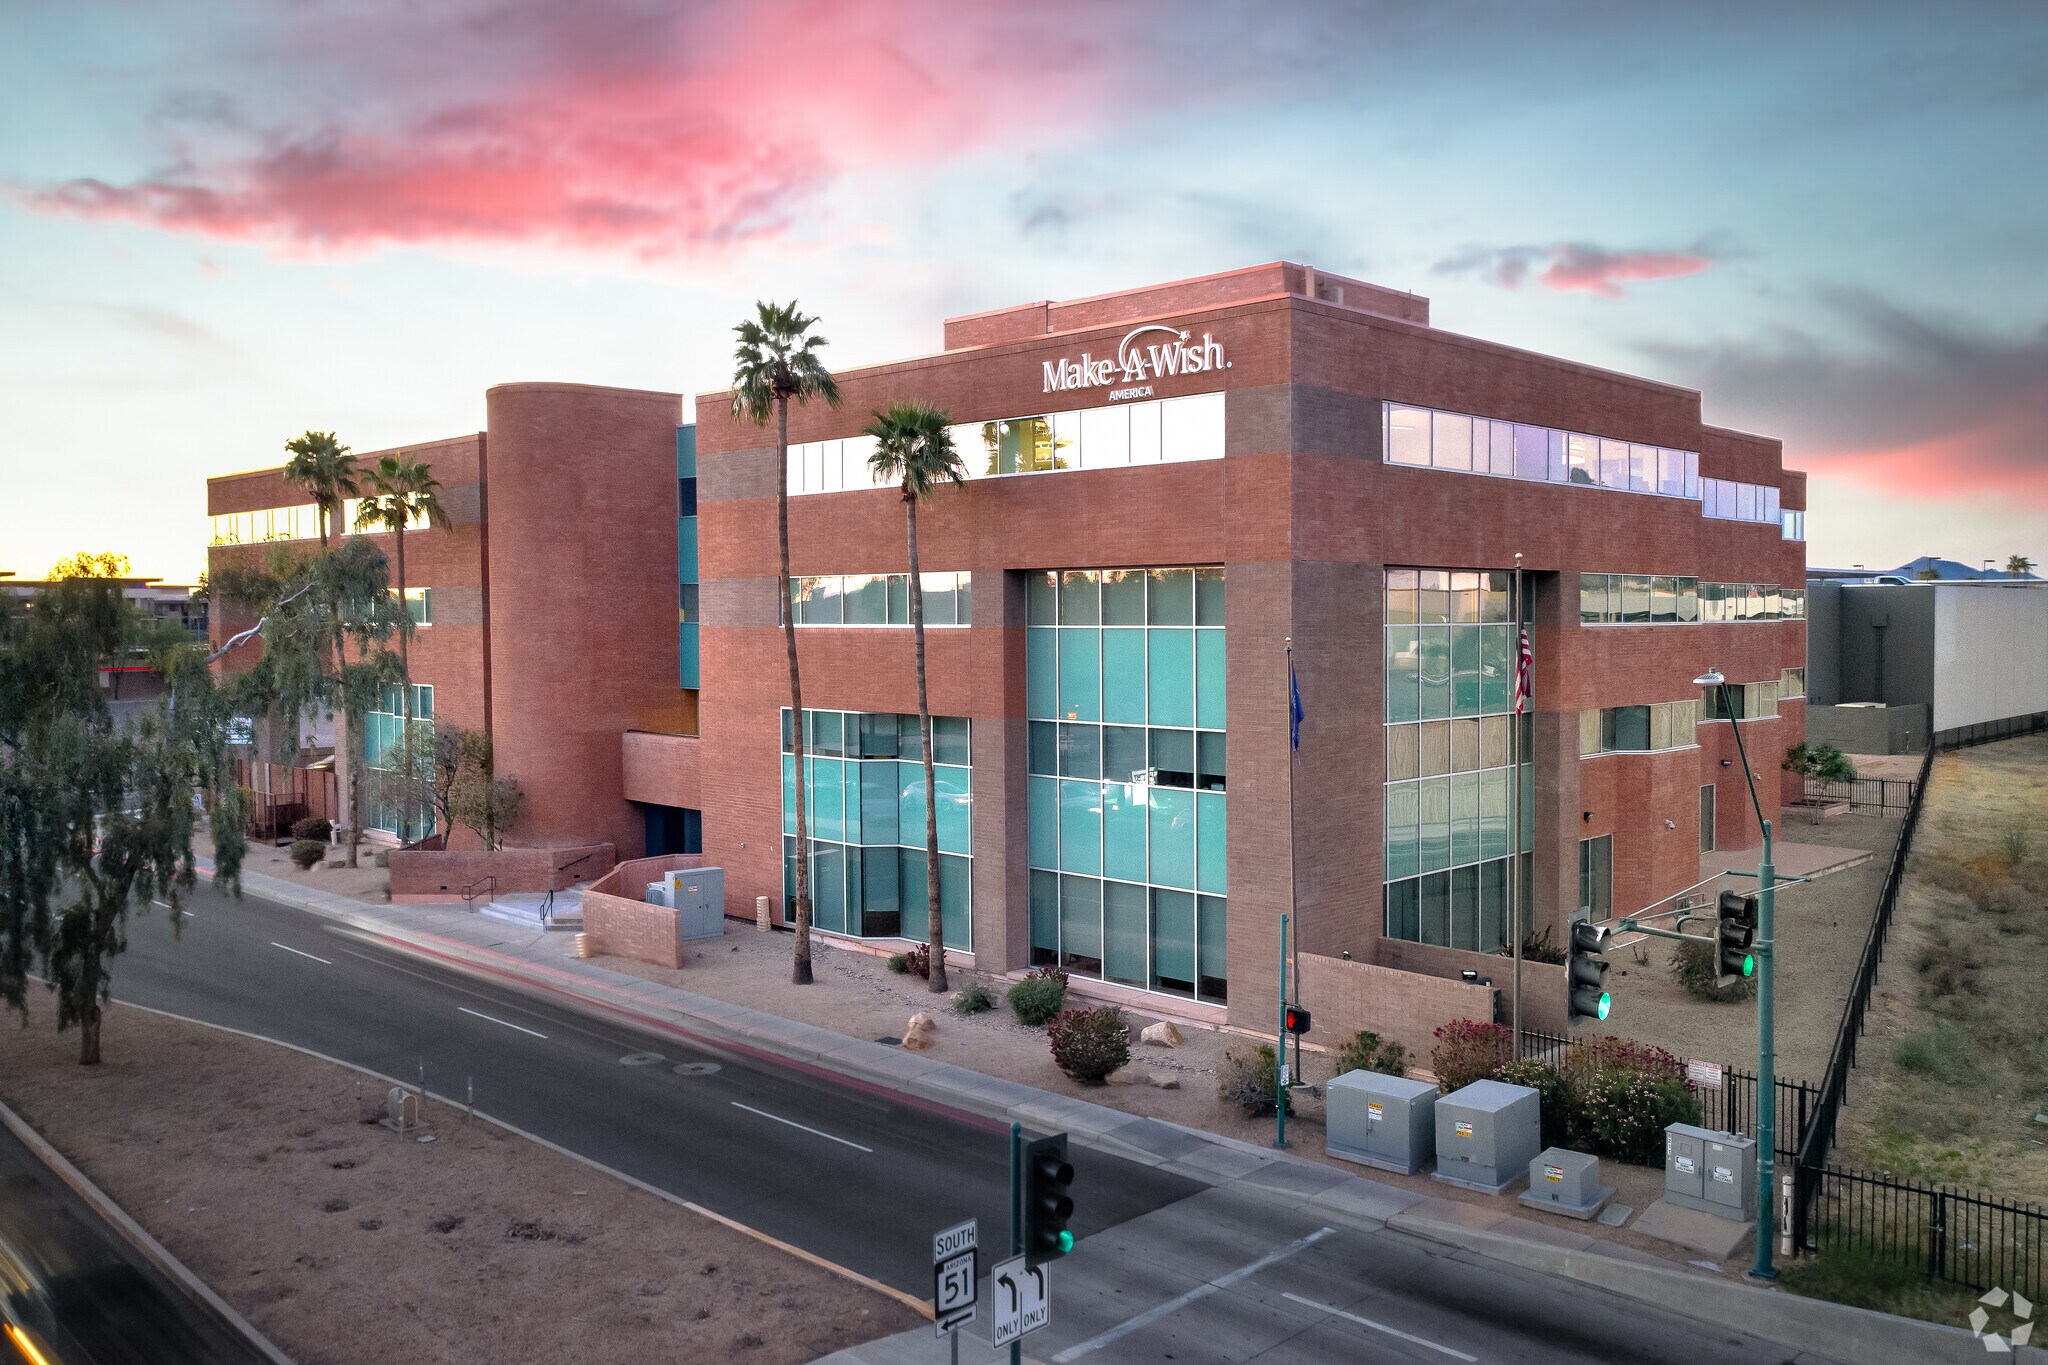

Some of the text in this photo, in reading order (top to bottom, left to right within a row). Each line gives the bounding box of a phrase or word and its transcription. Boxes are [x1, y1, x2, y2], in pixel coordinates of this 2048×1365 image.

[1108, 386, 1153, 401] AMERICA
[937, 1227, 975, 1255] SOUTH
[946, 1256, 972, 1271] ARIZONA
[945, 1267, 968, 1304] 51
[1024, 1307, 1046, 1327] ONLY
[996, 1319, 1018, 1340] ONLY
